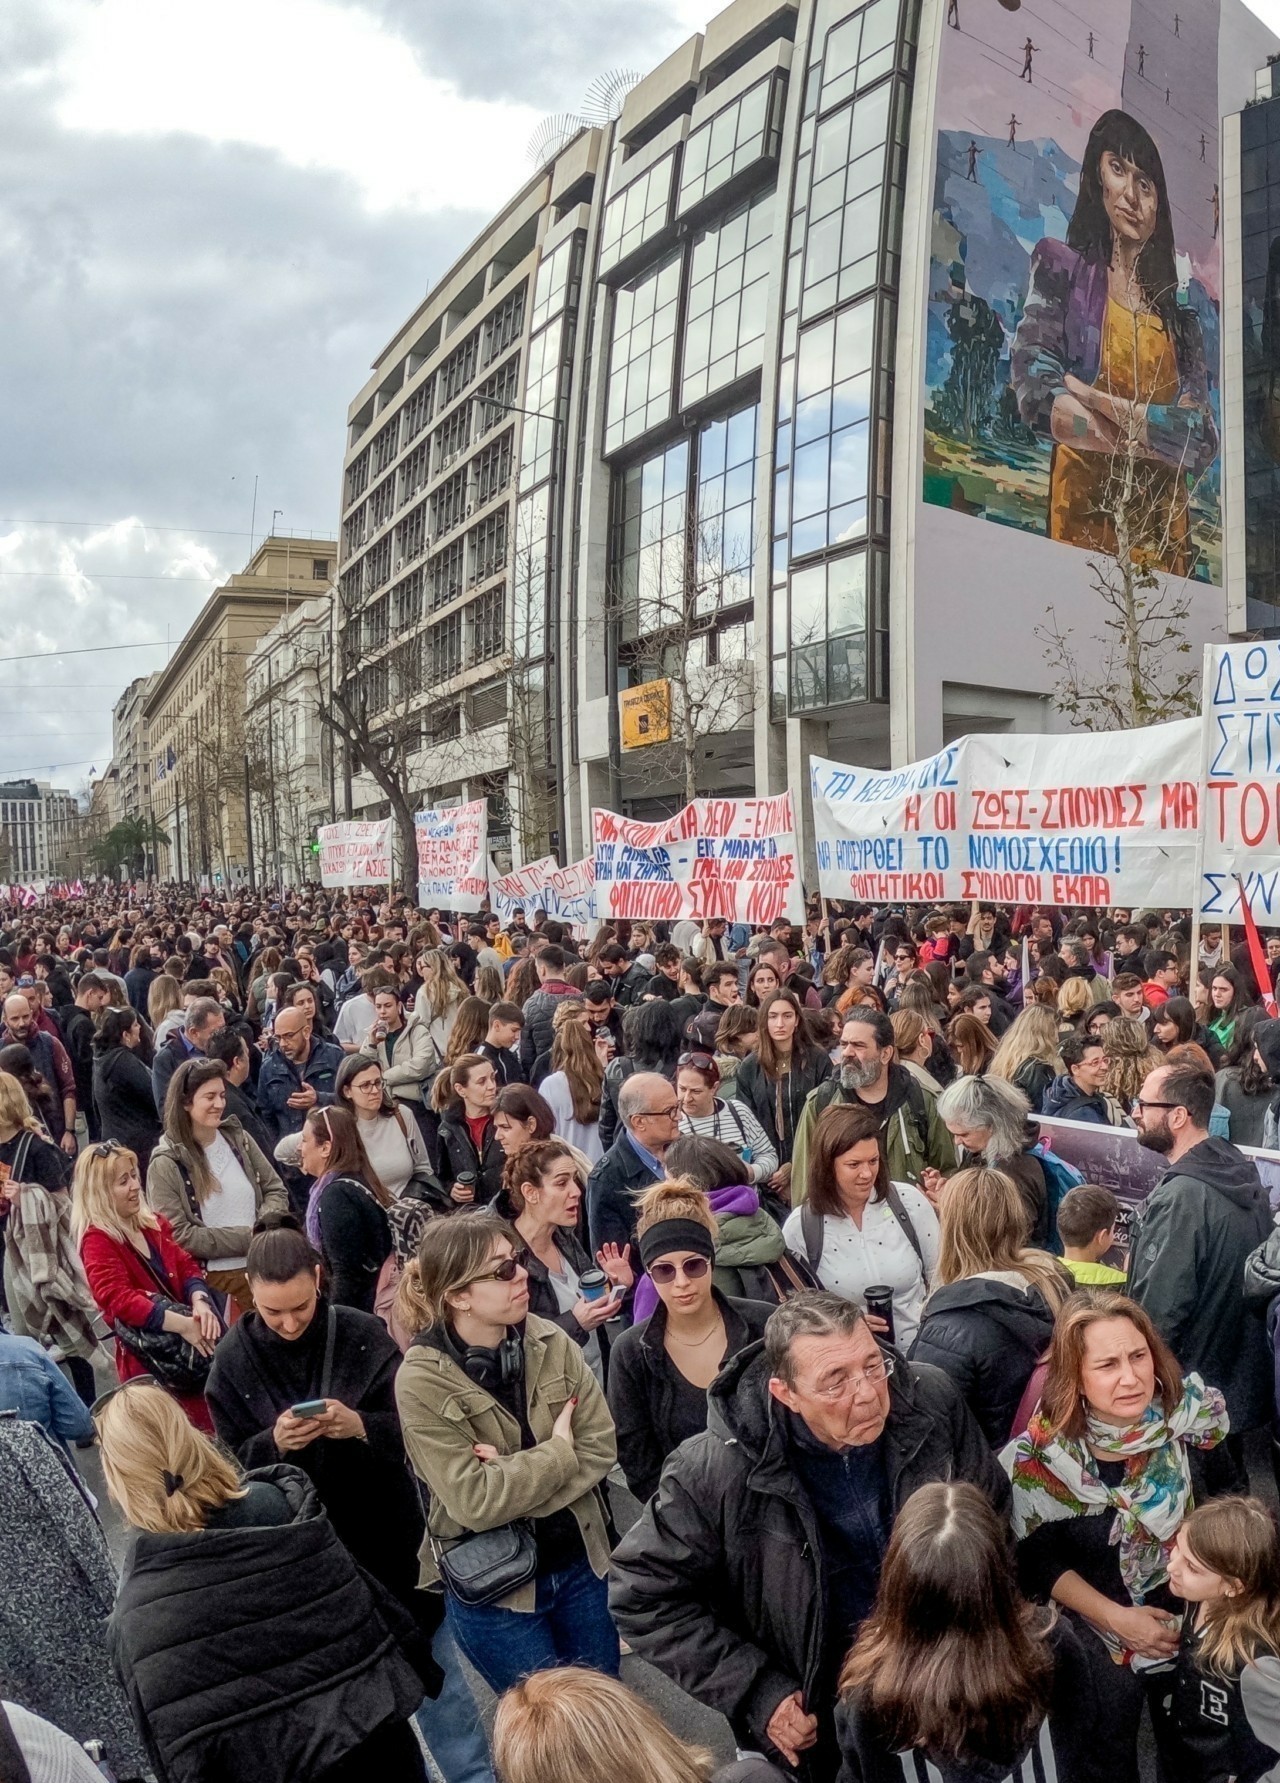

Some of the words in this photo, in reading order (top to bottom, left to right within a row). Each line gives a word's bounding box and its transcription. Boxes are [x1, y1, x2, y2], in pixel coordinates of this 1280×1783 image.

[824, 771, 856, 800] ΤΑ
[911, 747, 959, 791] ΟΥΣ
[704, 800, 736, 838] ΔΕΝ
[934, 791, 957, 831] ΟΙ
[1160, 782, 1199, 830] ΜΑ
[817, 841, 831, 870] ΝΑ
[917, 836, 949, 870] ΤΟ
[968, 834, 1121, 874] ΝΟΜΟΣΧΕΔΙΟ!
[850, 872, 945, 900] ΦΟΙΤΗΤΙΚΟΙ
[961, 871, 1042, 902] ΣΥΛΛΟΓΟΙ
[1053, 874, 1110, 905] ΕΚΠΑ
